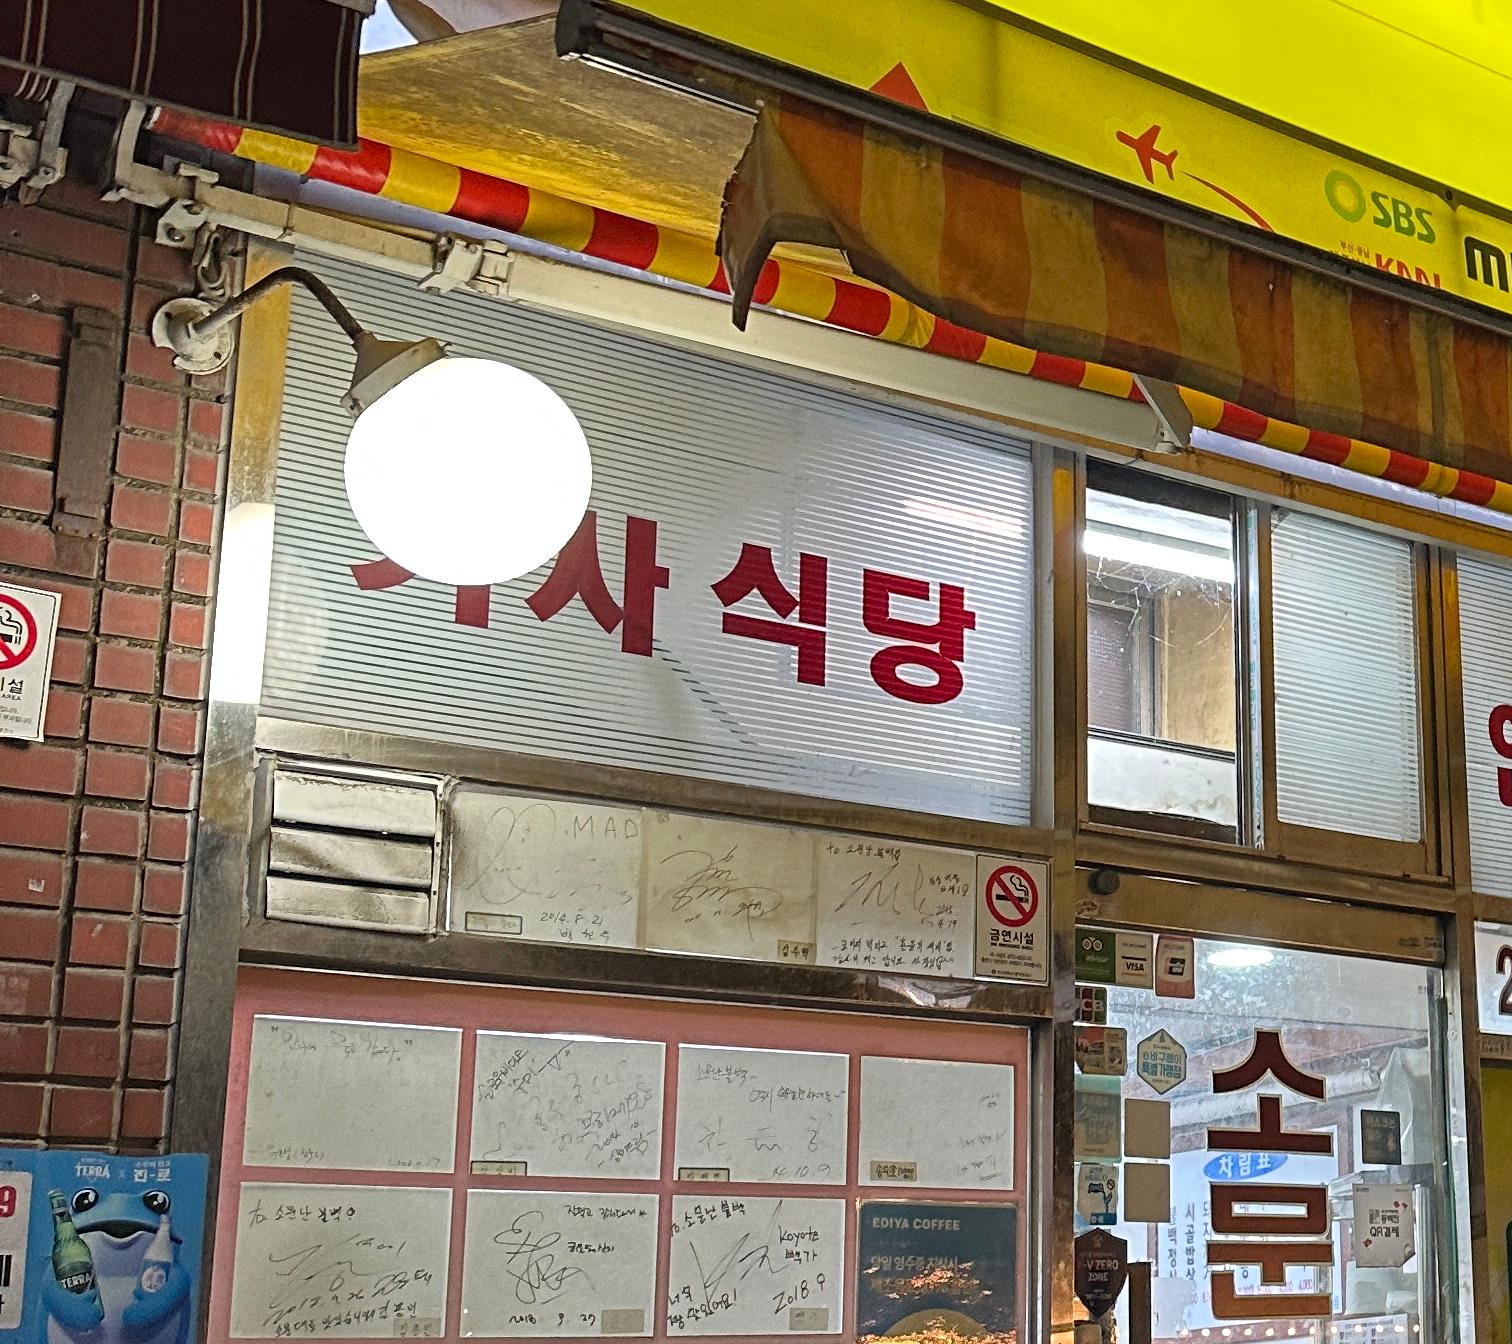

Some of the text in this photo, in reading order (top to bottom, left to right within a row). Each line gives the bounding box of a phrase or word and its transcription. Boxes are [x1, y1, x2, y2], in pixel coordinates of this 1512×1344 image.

[1371, 189, 1436, 245] SBS
[349, 509, 977, 705] 사식당
[990, 927, 1034, 946] 금연시설
[1125, 961, 1145, 972] VISA
[1218, 1152, 1273, 1179] 차림표
[872, 1217, 961, 1231] EDIYA COFFEE
